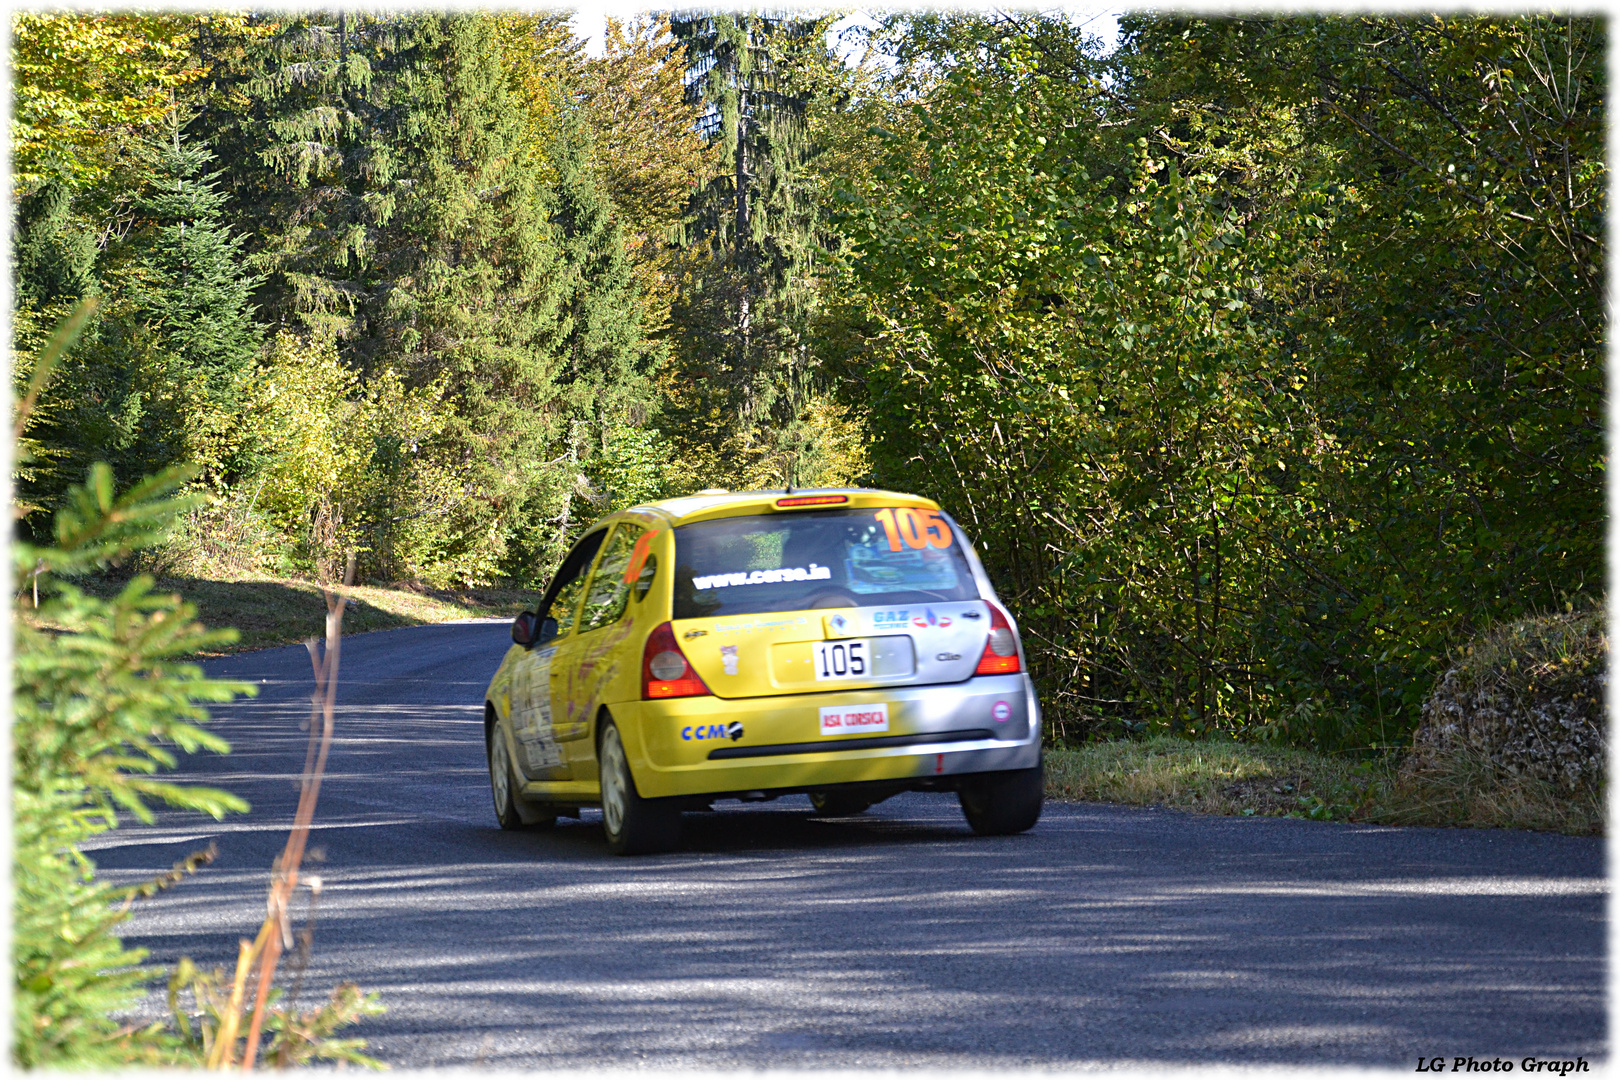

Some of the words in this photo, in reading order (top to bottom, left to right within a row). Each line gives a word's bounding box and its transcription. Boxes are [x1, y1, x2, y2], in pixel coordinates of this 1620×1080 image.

[874, 507, 953, 552] 105
[873, 610, 910, 623] GAZ
[822, 643, 865, 677] 105
[936, 652, 962, 662] Clio
[681, 724, 726, 740] CCM
